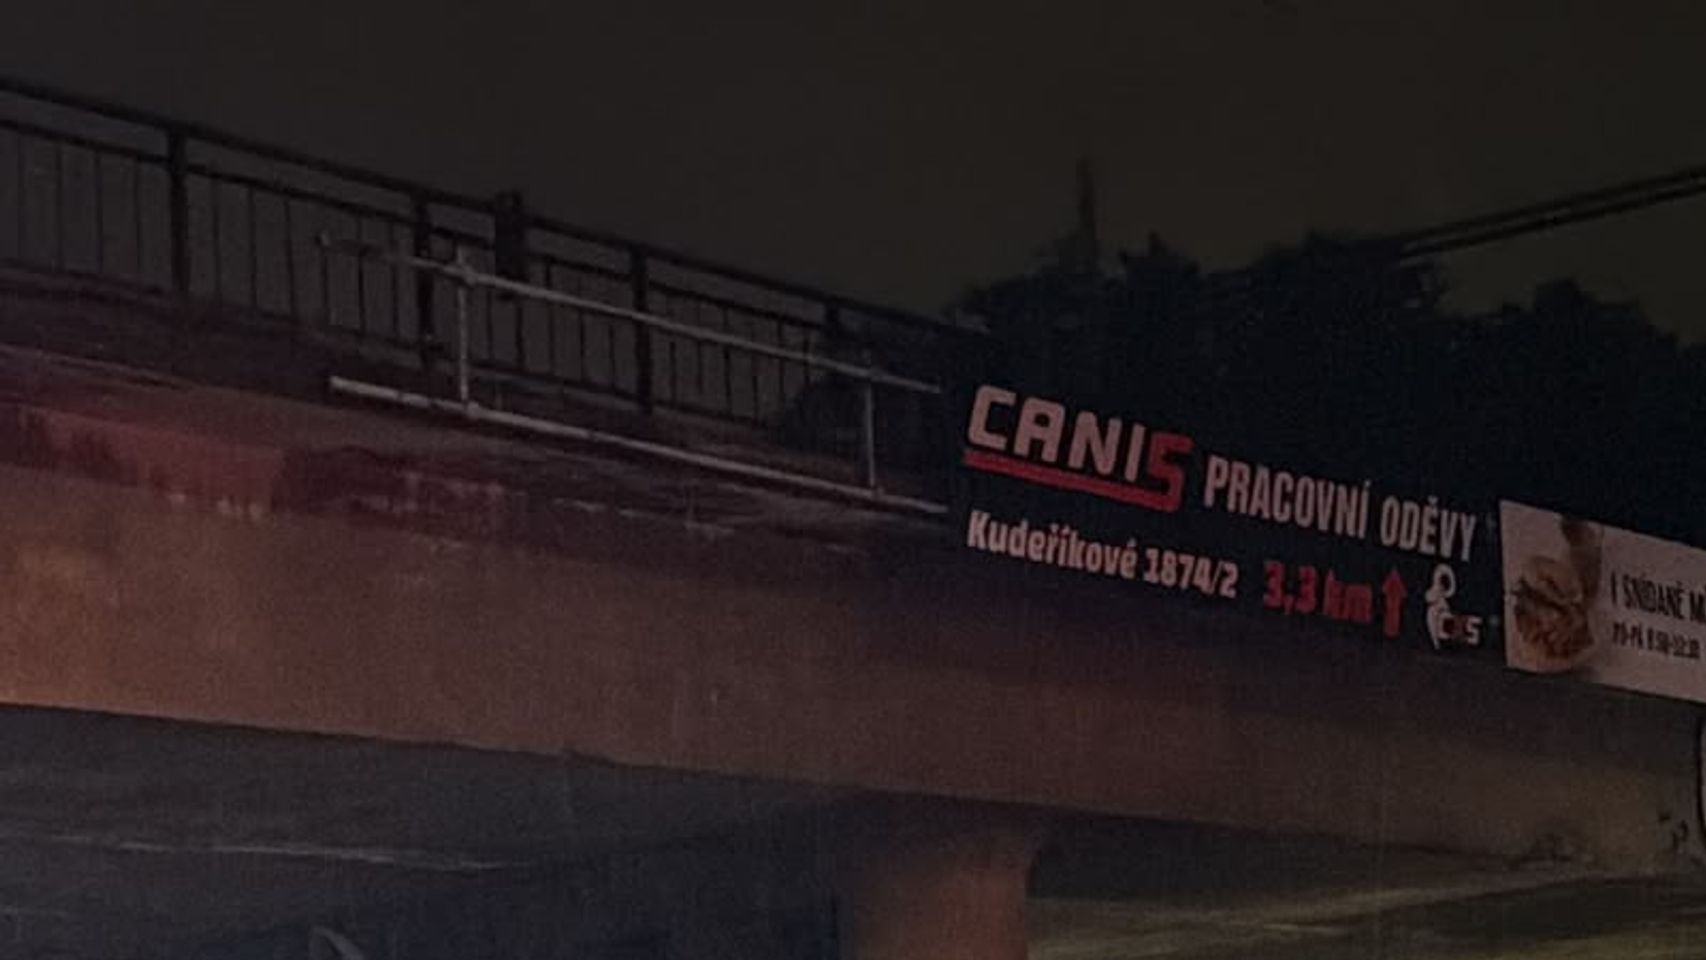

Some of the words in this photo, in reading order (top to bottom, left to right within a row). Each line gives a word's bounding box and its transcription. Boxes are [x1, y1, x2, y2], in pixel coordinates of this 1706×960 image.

[965, 384, 1194, 512] CANIS
[1204, 454, 1371, 540] PRACOVNÍ
[1380, 495, 1478, 562] ODĚVY
[967, 509, 1137, 579] Kudeříkové
[1143, 547, 1240, 598] 1874/2
[1262, 558, 1318, 614] 3,3
[1323, 572, 1374, 624] km
